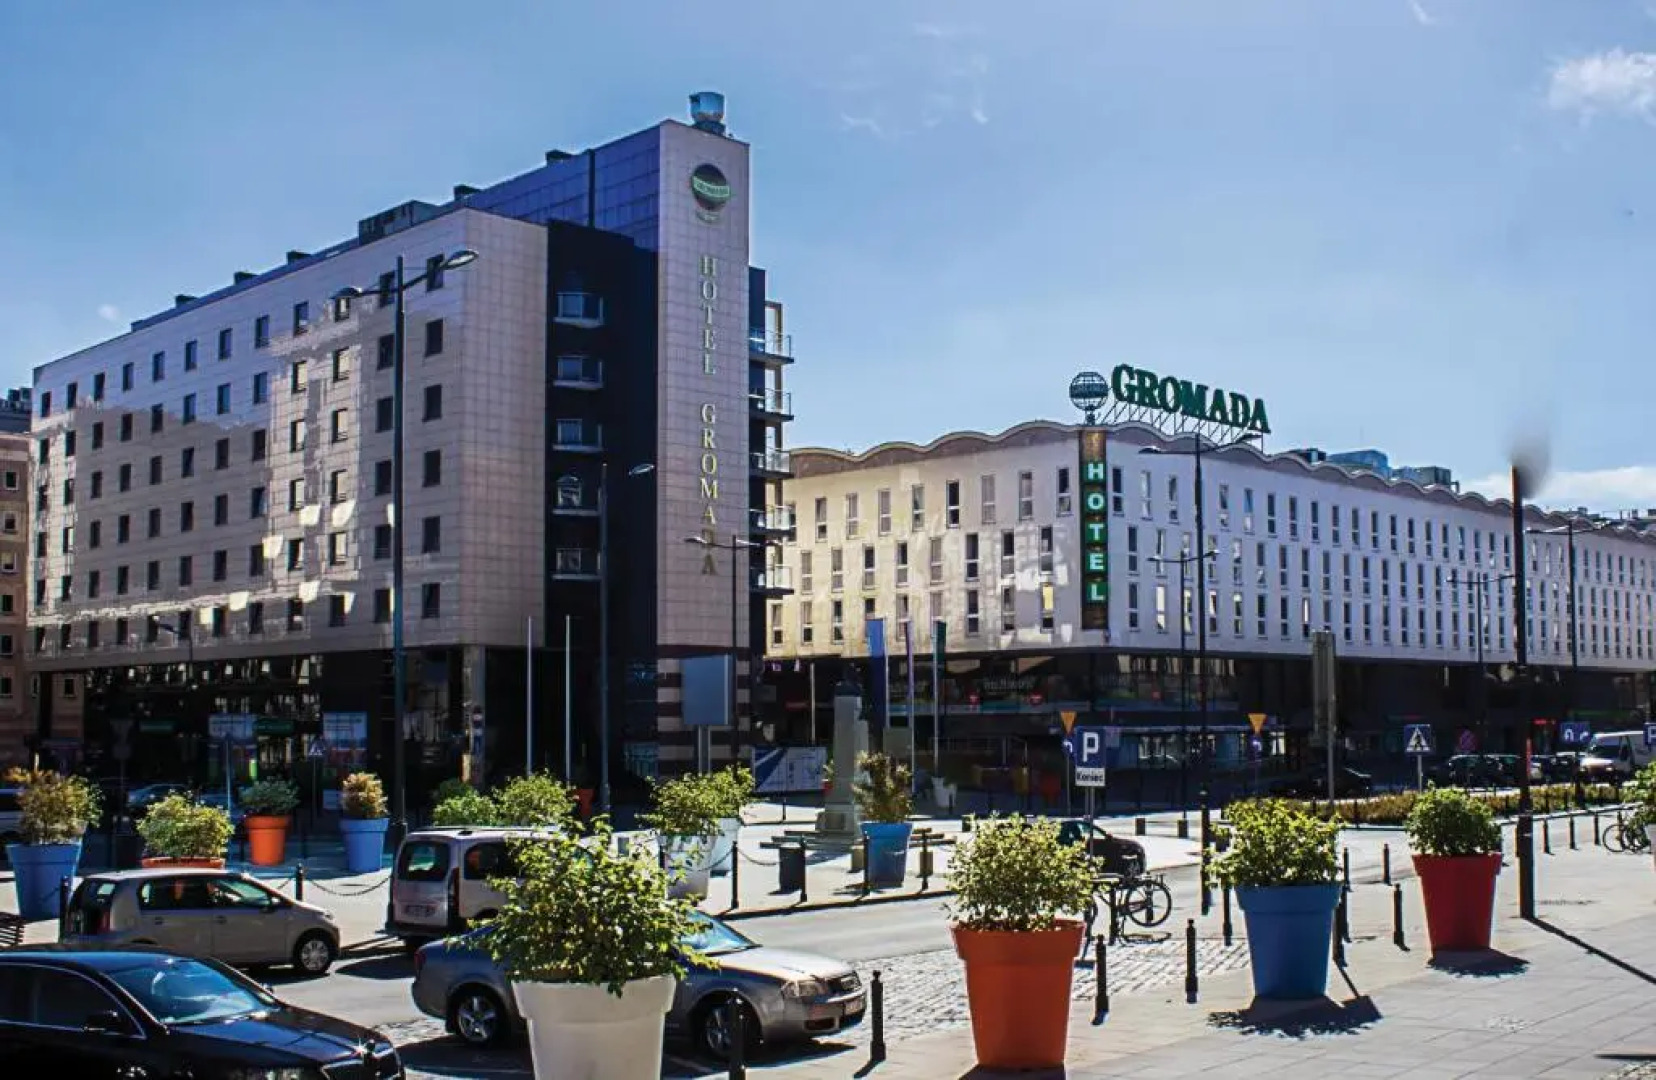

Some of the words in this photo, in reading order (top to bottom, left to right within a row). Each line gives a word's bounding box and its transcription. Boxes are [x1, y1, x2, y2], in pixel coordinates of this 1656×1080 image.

[701, 256, 718, 375] HOTEL
[1111, 363, 1271, 434] GROMADA
[700, 403, 719, 576] GROMADA
[1087, 463, 1106, 601] HOTEL
[1083, 731, 1099, 762] P
